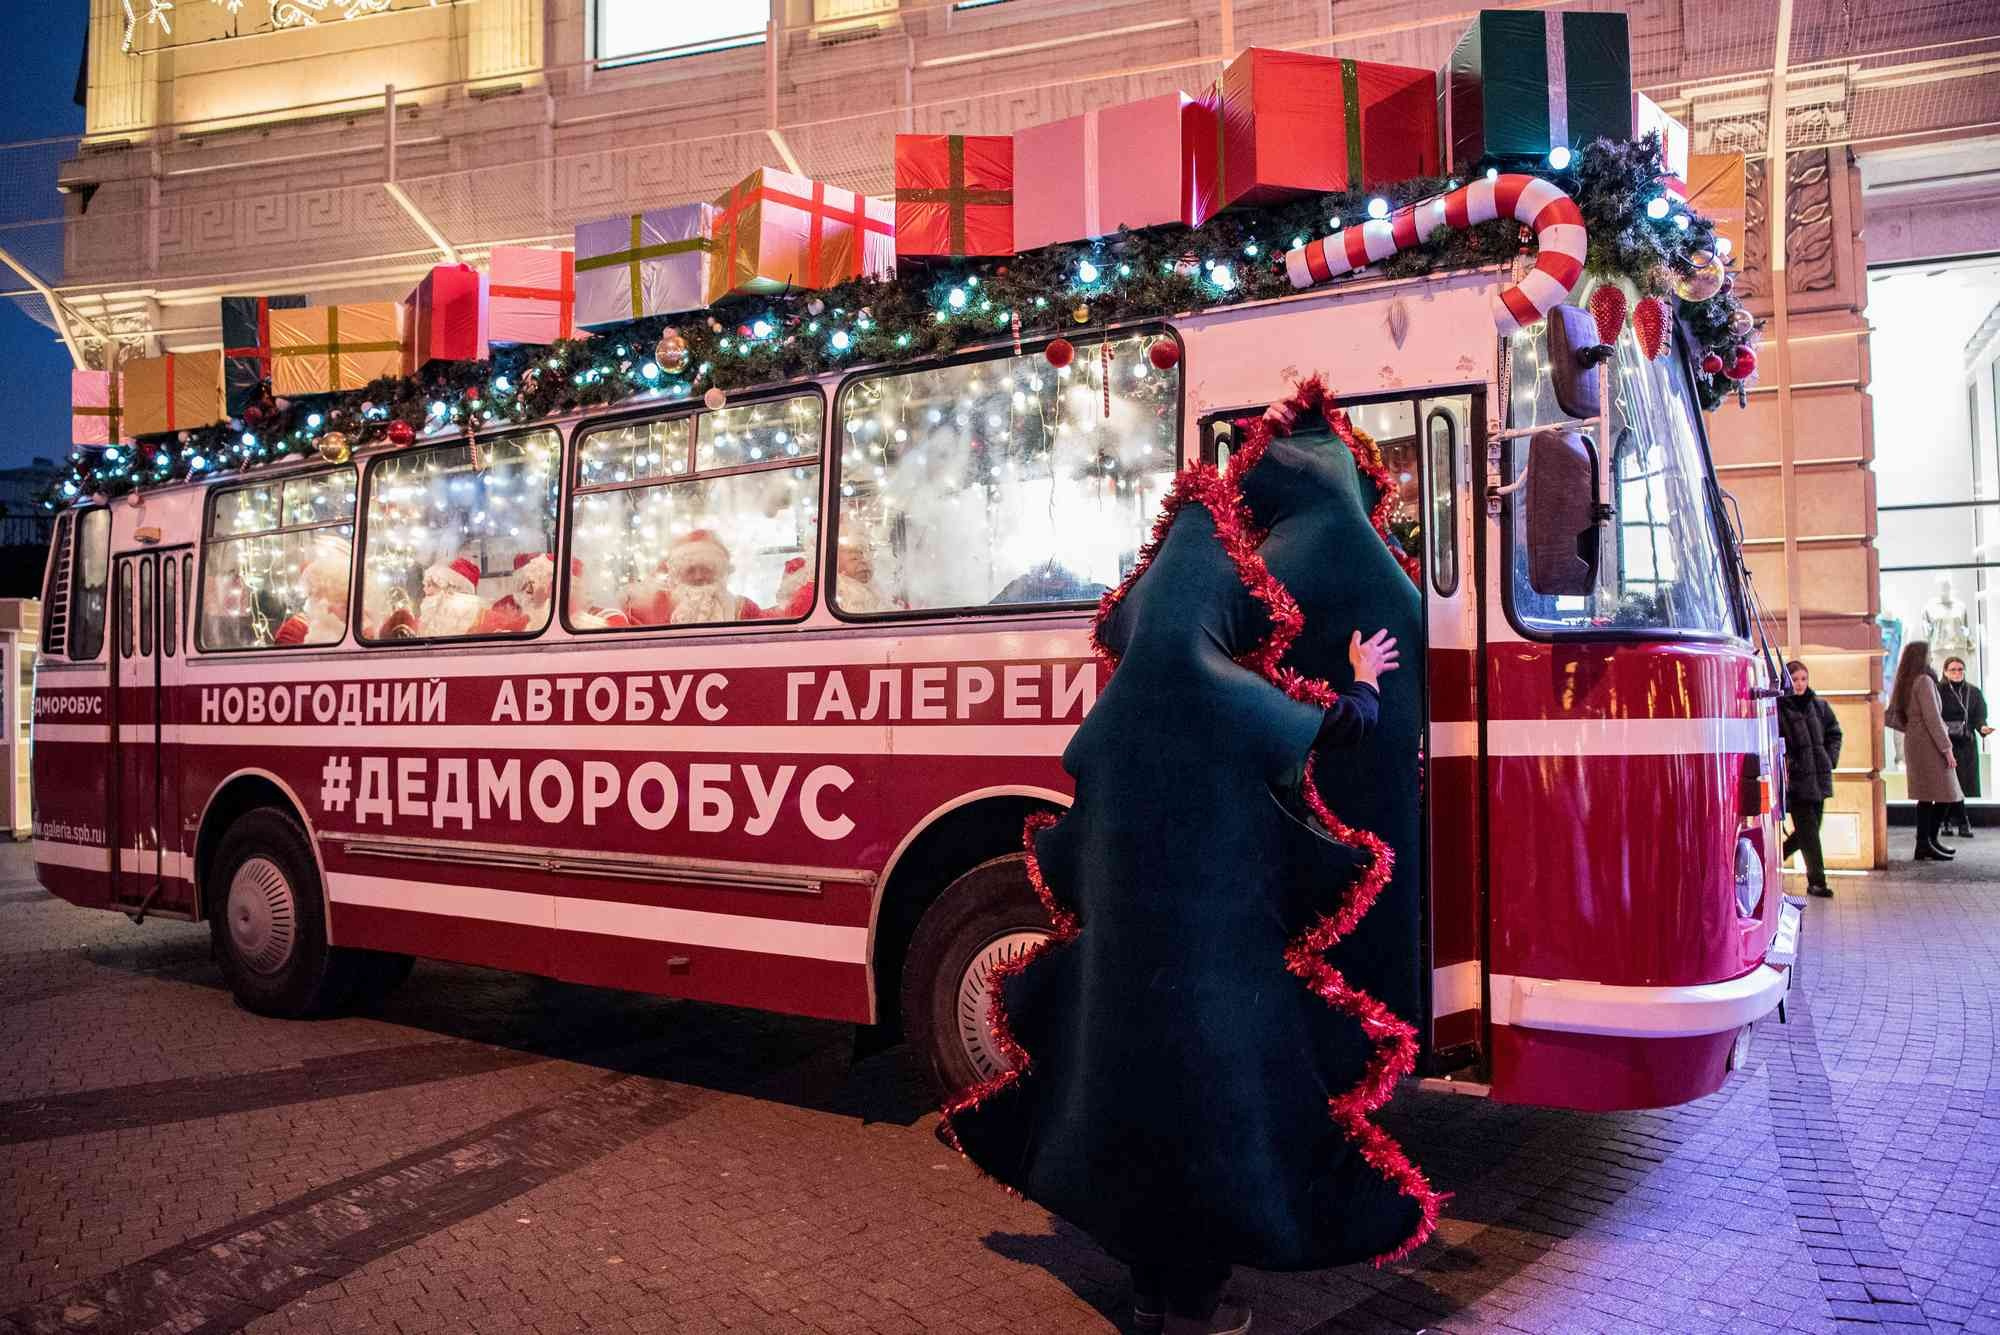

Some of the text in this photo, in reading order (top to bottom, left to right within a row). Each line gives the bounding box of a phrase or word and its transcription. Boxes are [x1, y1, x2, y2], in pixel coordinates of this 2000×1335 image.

[201, 663, 1097, 726] НОВОГОДНИЙ АВТОБУС ГАЛЕРЕИ
[320, 755, 856, 841] #ДЕДМОРОБУС
